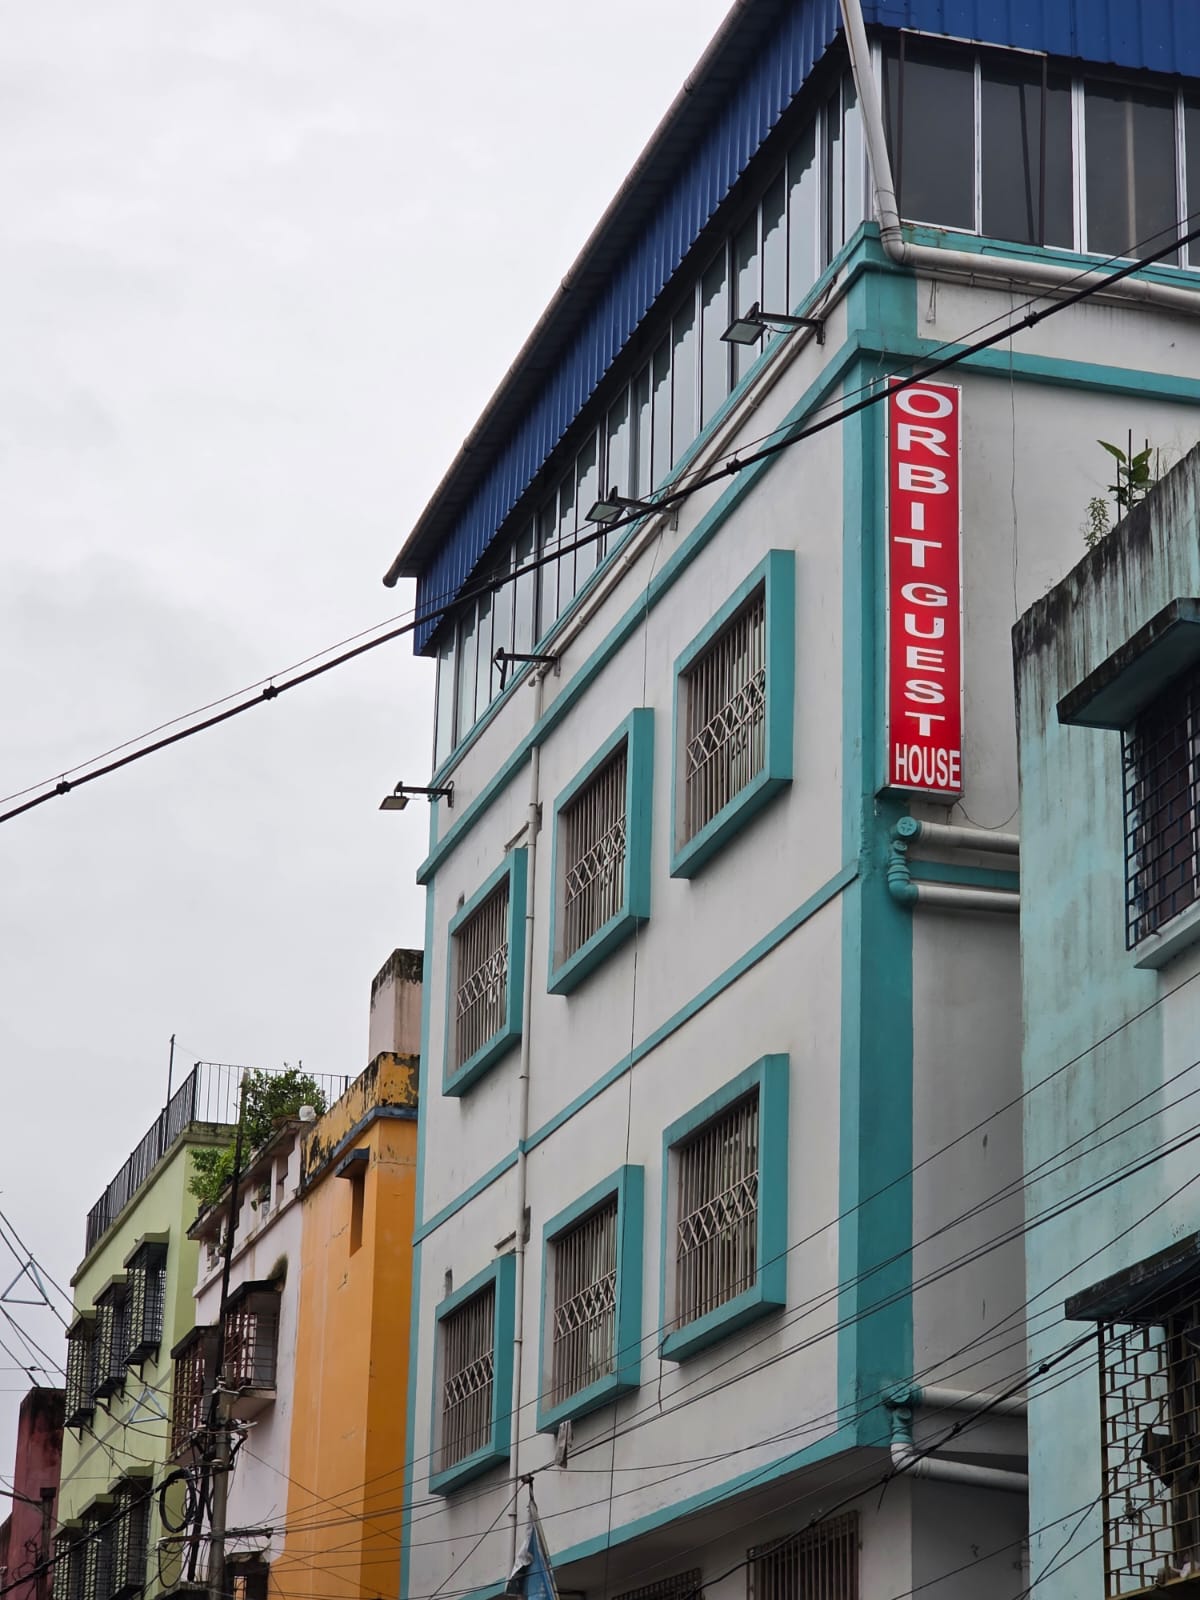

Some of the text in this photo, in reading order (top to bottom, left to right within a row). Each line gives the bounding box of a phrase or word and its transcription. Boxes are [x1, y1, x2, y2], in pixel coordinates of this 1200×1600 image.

[894, 388, 954, 737] ORBIT GUEST
[895, 742, 961, 788] HOUSE
